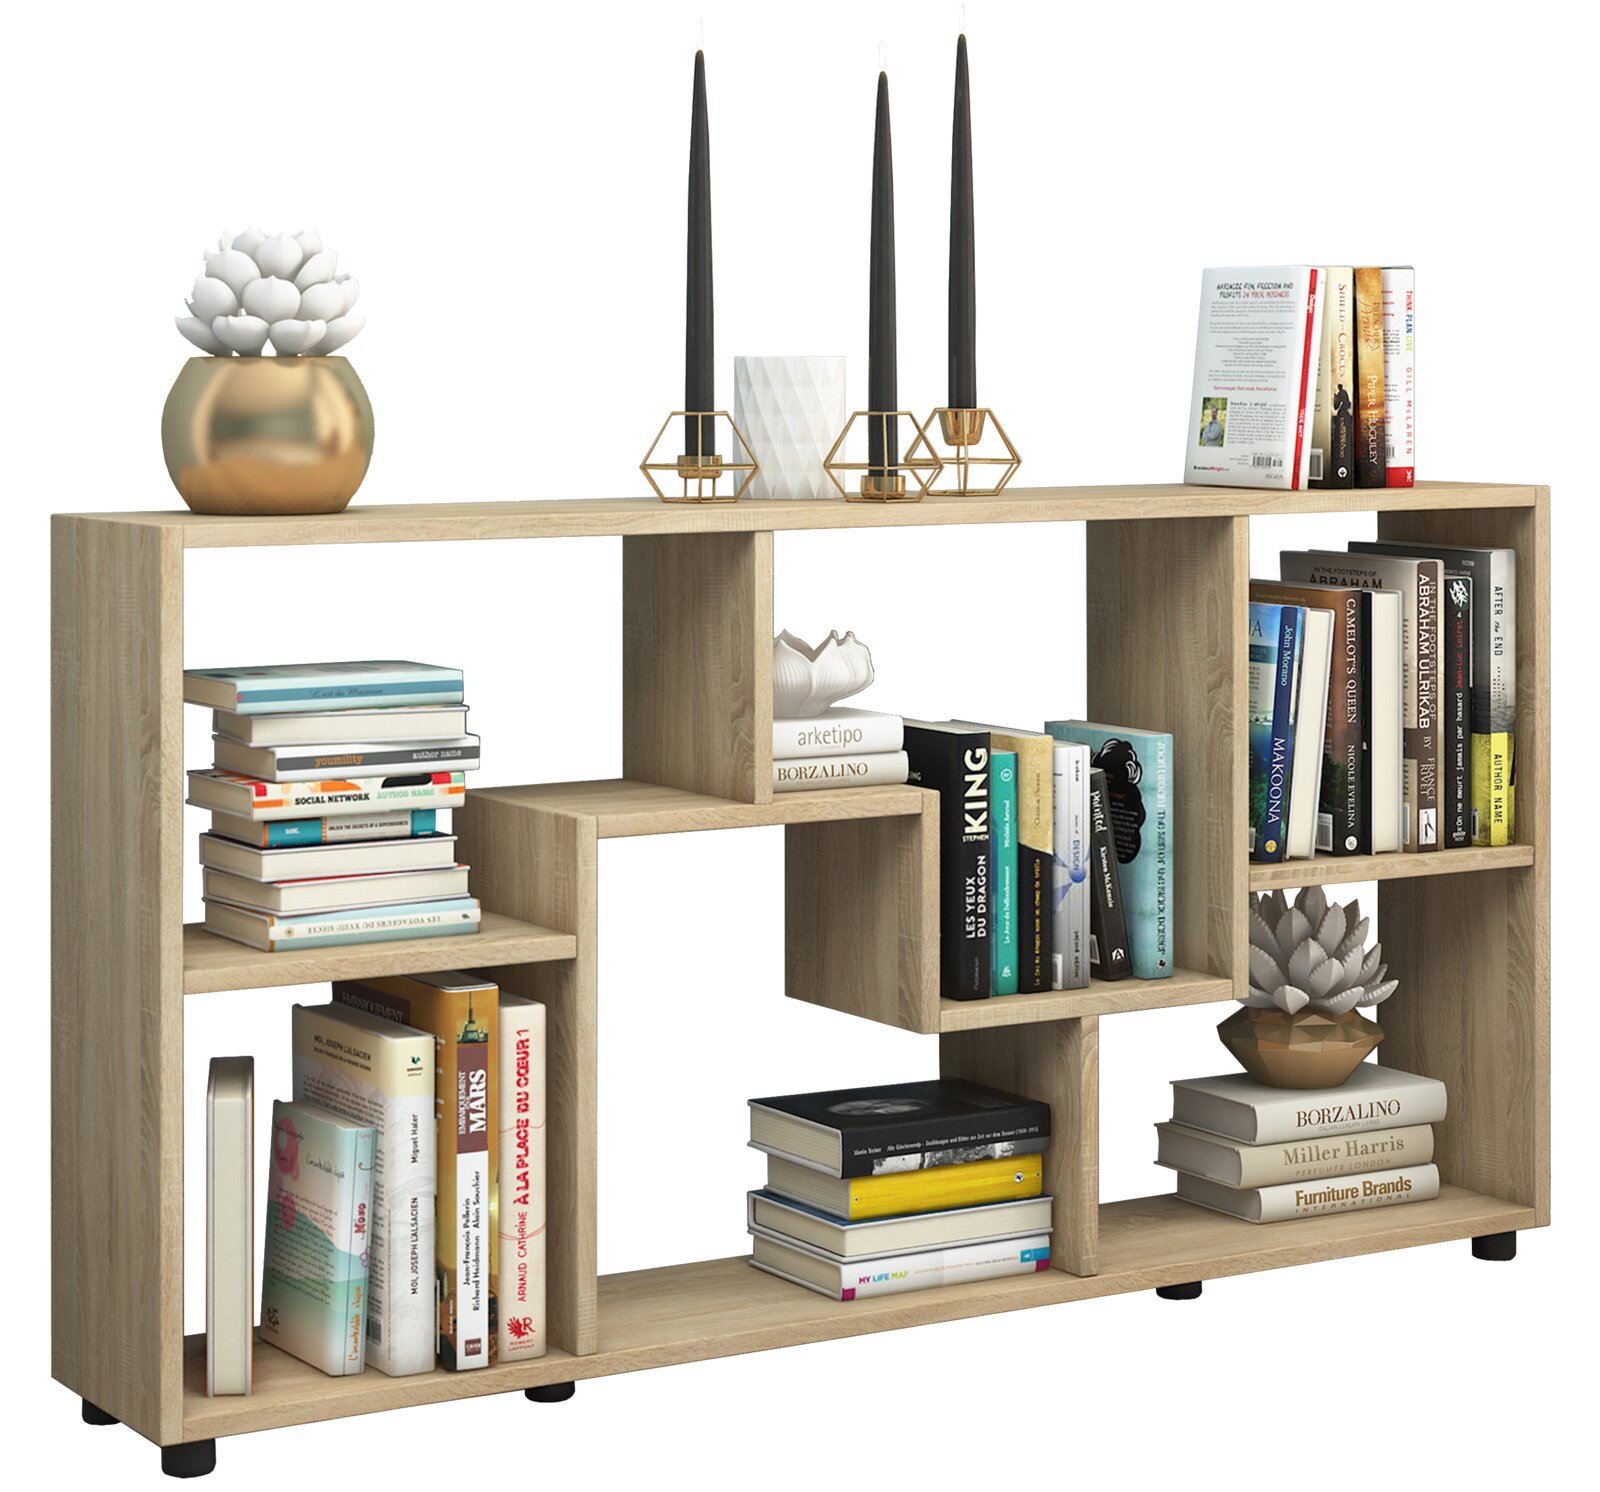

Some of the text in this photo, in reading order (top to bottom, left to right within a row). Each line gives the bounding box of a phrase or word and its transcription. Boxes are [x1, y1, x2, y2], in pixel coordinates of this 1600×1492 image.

[1368, 375, 1378, 464] PIPER HUGULEY
[1310, 573, 1382, 589] ABRAHAM
[1334, 568, 1368, 576] FOOTSTEPS
[1429, 582, 1436, 594] IN
[1494, 586, 1503, 615] AFTER
[1280, 625, 1293, 686] John Morano
[1346, 598, 1357, 723] CAMELOT'S QUEEN
[1419, 574, 1430, 729] ABRAHAM ULRIKAB
[1494, 637, 1503, 656] END
[1429, 626, 1437, 699] FOOTSTEPS
[1429, 704, 1436, 721] OF
[798, 724, 863, 748] arketipo
[1423, 736, 1431, 749] BY
[315, 754, 363, 768] youmility
[412, 751, 439, 760] author
[777, 762, 868, 781] BORZALINO
[1456, 743, 1464, 771] jamais
[964, 748, 988, 833] KING
[1267, 737, 1286, 823] MAKOONA
[1347, 744, 1355, 828] NICOLE EVELINA
[1420, 764, 1428, 795] RIVET
[1427, 758, 1435, 800] FRANCE
[1494, 754, 1502, 823] AUTHOR NAME
[295, 788, 435, 805] SOCIAL NETWORK AUTHOR NAME
[962, 834, 989, 842] STEPHEN
[965, 876, 975, 938] LES YEUX
[977, 855, 986, 937] DU DRAGON
[469, 1069, 486, 1133] MARS
[1296, 1099, 1400, 1127] BORZALINO
[513, 1029, 530, 1205] À LA PLACE DU CŒUR 1
[411, 1114, 419, 1163] Miguel Haler
[1282, 1136, 1405, 1166] Miller Harris
[1296, 1158, 1392, 1177] PERFUMER LONDON
[1295, 1176, 1412, 1207] Furniture Brands
[1296, 1193, 1411, 1213] INTERNATIONAL
[472, 1171, 480, 1311] Richard Heidmann Alain Souchier
[411, 1244, 419, 1274] JOSEPH
[518, 1262, 527, 1302] ARNAUD
[859, 1270, 909, 1284] MY LIFE MAP
